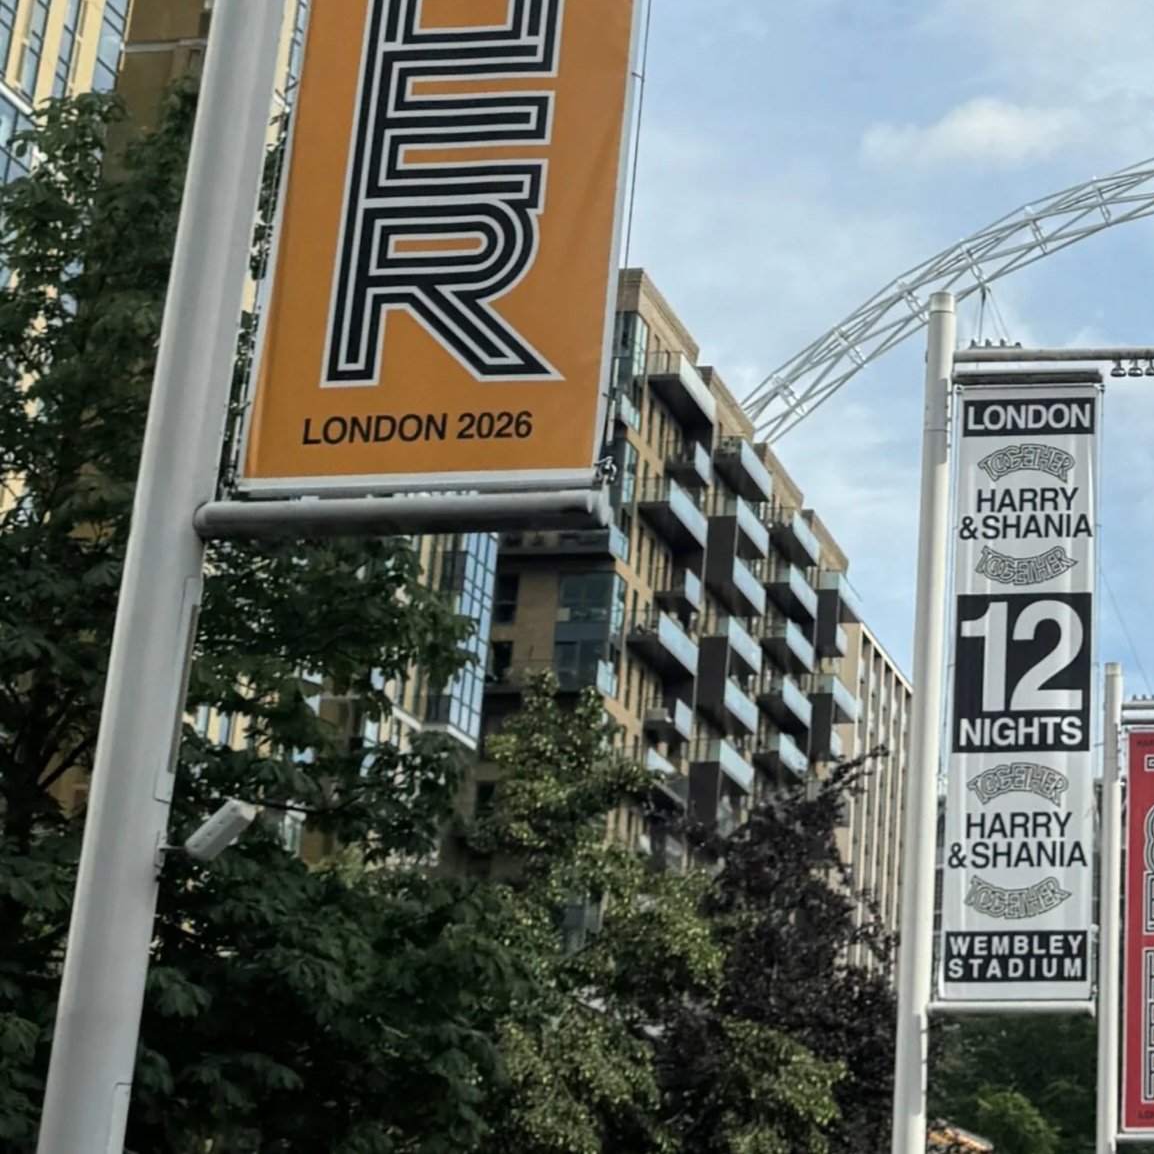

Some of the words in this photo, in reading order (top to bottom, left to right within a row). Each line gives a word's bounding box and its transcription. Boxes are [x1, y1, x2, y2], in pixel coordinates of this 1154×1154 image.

[302, 413, 447, 445] LONDON
[457, 411, 533, 440] 2026
[967, 403, 1091, 431] LONDON
[977, 443, 1075, 484] TOGETHER
[976, 487, 1079, 513] HARRY
[974, 545, 1078, 586] TOGETHER
[961, 600, 1083, 712] 12
[959, 716, 1083, 746] NIGHTS
[966, 763, 1069, 807] TOGETHER
[966, 812, 1072, 839] HARRY
[964, 875, 1072, 920] TOGETHER
[949, 935, 1083, 957] WEMBLEY
[948, 958, 1083, 978] STADIUM
